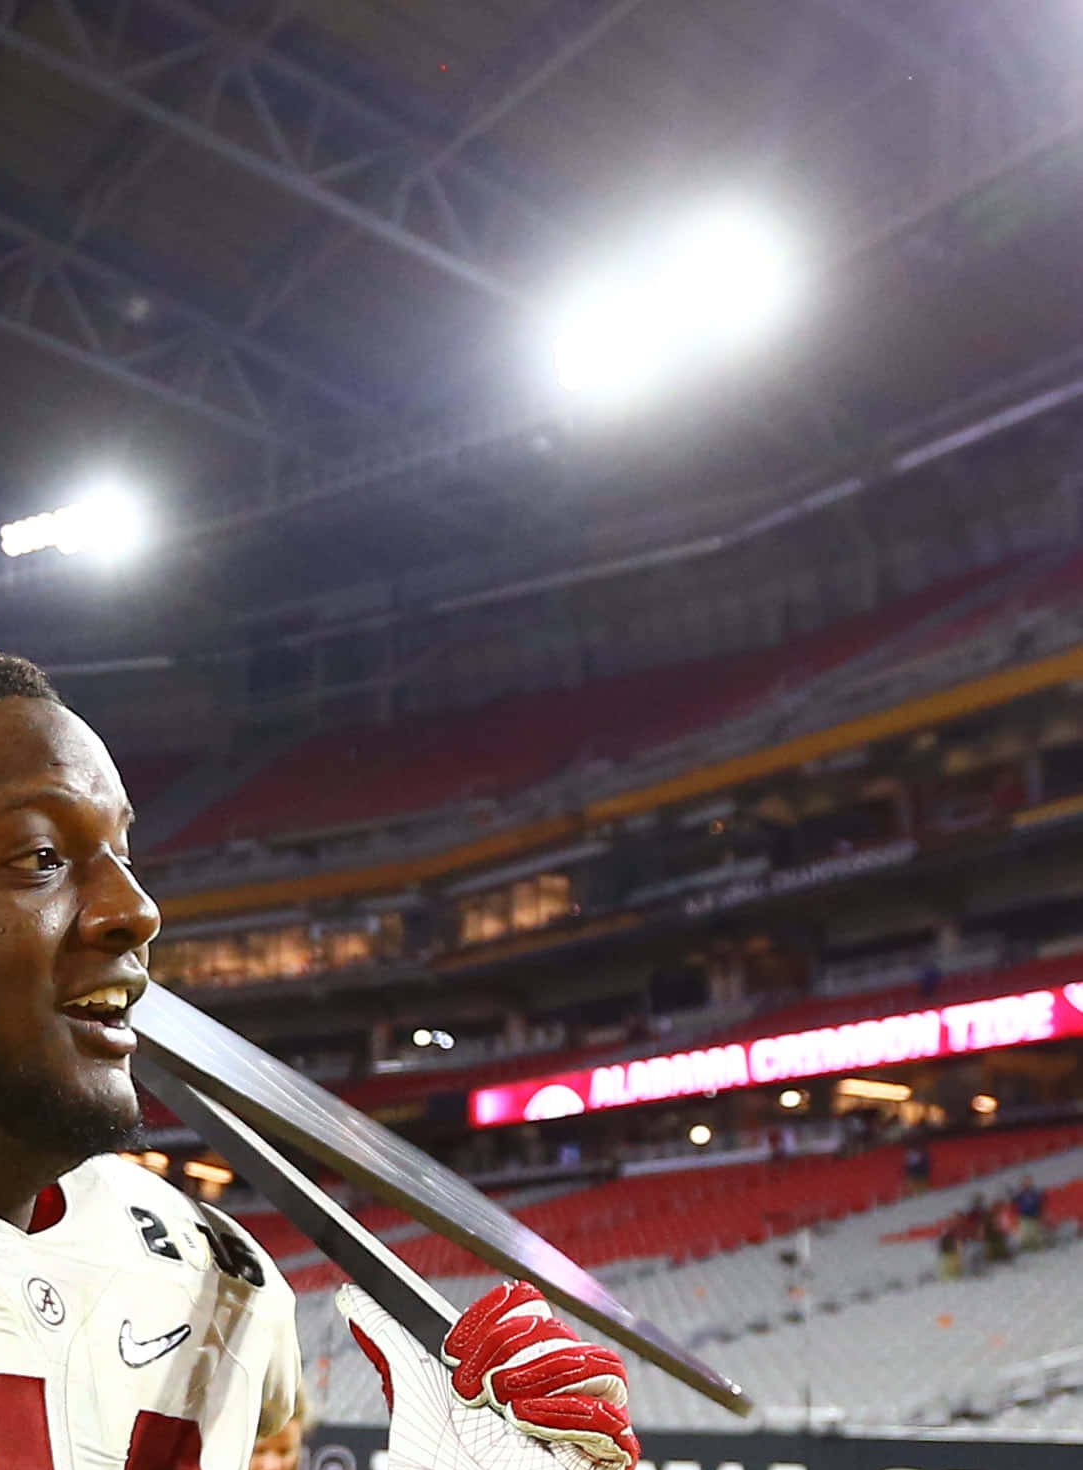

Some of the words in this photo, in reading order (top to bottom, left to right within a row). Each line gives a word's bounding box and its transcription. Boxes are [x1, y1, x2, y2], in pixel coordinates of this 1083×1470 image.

[591, 1046, 748, 1105] ALABAMA
[751, 1011, 940, 1081] CRIMSON
[944, 991, 1054, 1049] TIDE
